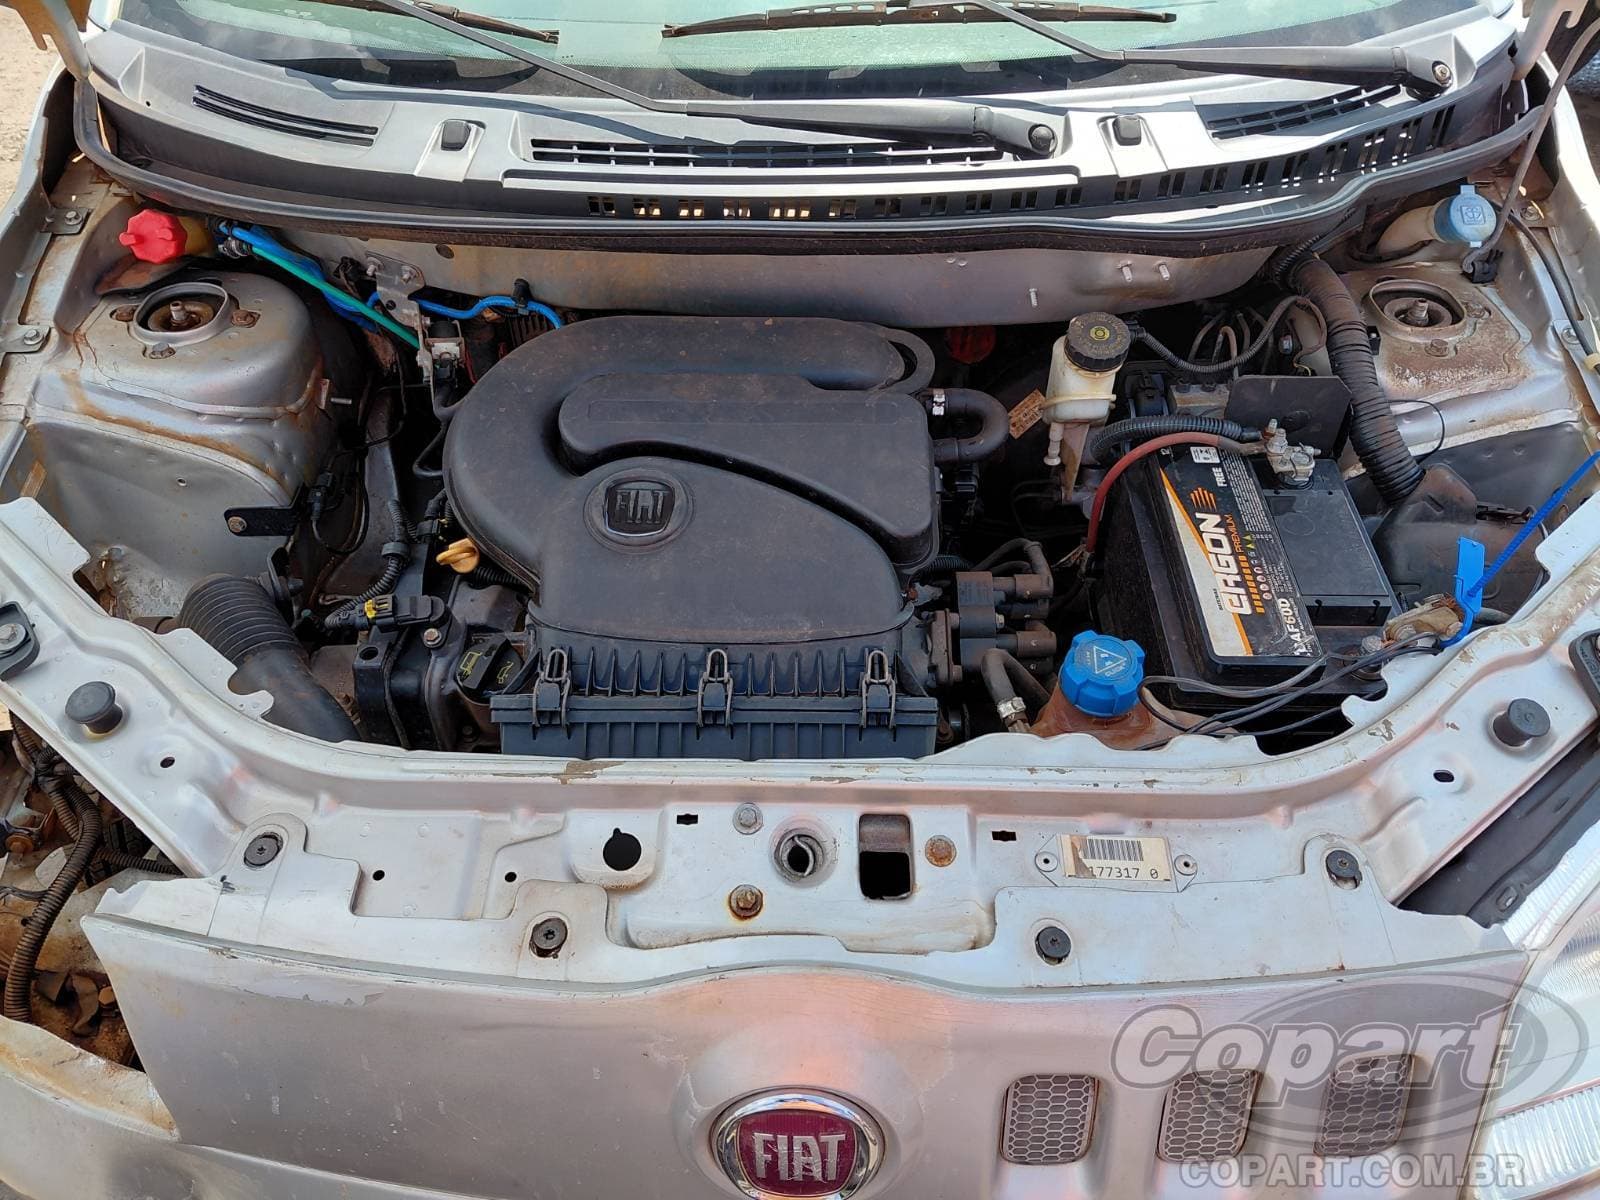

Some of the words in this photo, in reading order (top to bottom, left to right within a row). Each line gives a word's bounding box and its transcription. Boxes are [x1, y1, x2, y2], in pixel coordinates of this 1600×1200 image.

[1212, 467, 1227, 487] FREE
[615, 489, 669, 524] FIAT
[1224, 513, 1244, 553] PREMIUM
[753, 1132, 846, 1181] FIAT
